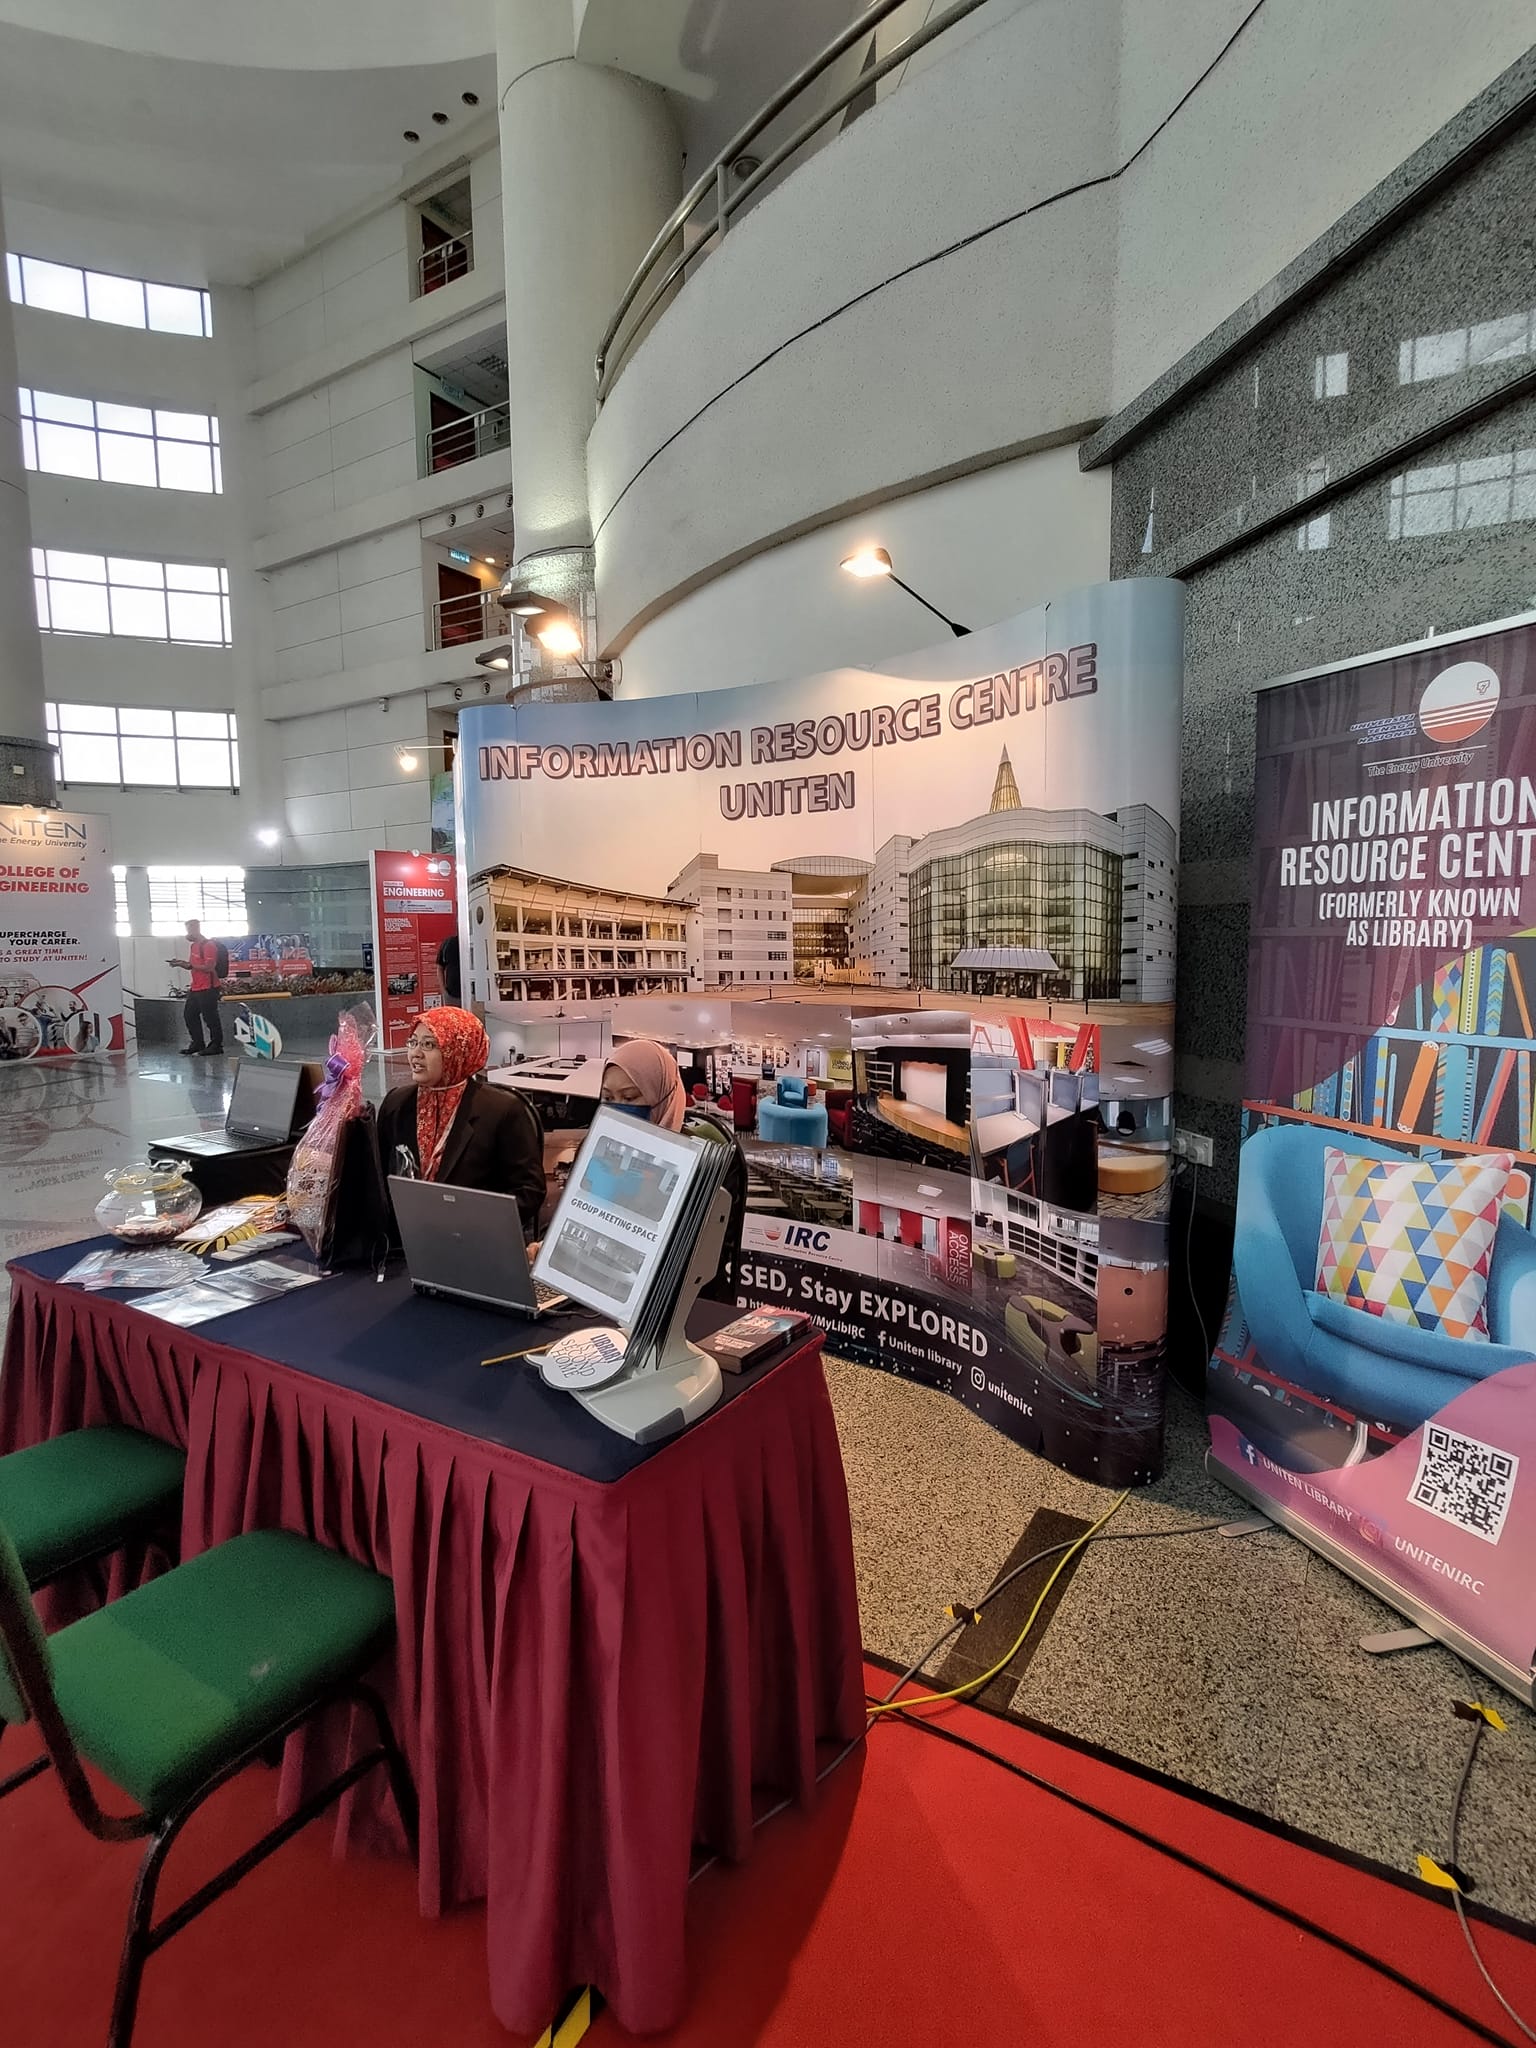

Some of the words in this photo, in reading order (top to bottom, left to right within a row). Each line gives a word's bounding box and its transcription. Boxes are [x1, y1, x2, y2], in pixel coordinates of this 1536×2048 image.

[479, 730, 741, 781] INFORMATION
[750, 694, 942, 765] RESOURCE
[949, 642, 1098, 730] CENTRE
[1350, 713, 1416, 731] UNIVERSITI
[1367, 721, 1415, 735] TENAGA
[1357, 728, 1417, 744] NASIONAL
[1368, 765, 1385, 777] The
[1386, 760, 1420, 774] Energy
[1421, 752, 1475, 769] University
[719, 771, 855, 822] UNITEN
[1311, 776, 1536, 842] INFORMATION
[10, 837, 42, 846] Energy
[45, 839, 87, 848] University
[1280, 835, 1429, 886] RESOURCE
[59, 867, 80, 878] OF
[383, 887, 445, 898] ENGINEERING
[1319, 889, 1424, 920] (FORMERLY
[1428, 887, 1521, 917] KNOWN
[1346, 920, 1369, 946] AS
[1373, 918, 1473, 949] LIBRARY)
[570, 1198, 599, 1215] GROUP
[598, 1209, 632, 1232] MEETING
[631, 1225, 659, 1243] SPACE
[784, 1225, 831, 1252] IRC
[948, 1229, 960, 1284] ACCESS
[959, 1233, 969, 1289] ONLINE
[800, 1275, 853, 1315] Stay
[859, 1289, 989, 1358] EXPLORED
[550, 1348, 580, 1379] HOME
[561, 1339, 596, 1377] SECOND
[590, 1333, 625, 1364] LIBRARY
[889, 1336, 926, 1359] Uniten
[926, 1348, 963, 1376] library
[988, 1380, 1034, 1417] unitenirc
[1262, 1456, 1302, 1491] UNITEN
[1303, 1483, 1354, 1523] LIBRARY
[1394, 1535, 1485, 1596] UNITENIRC
